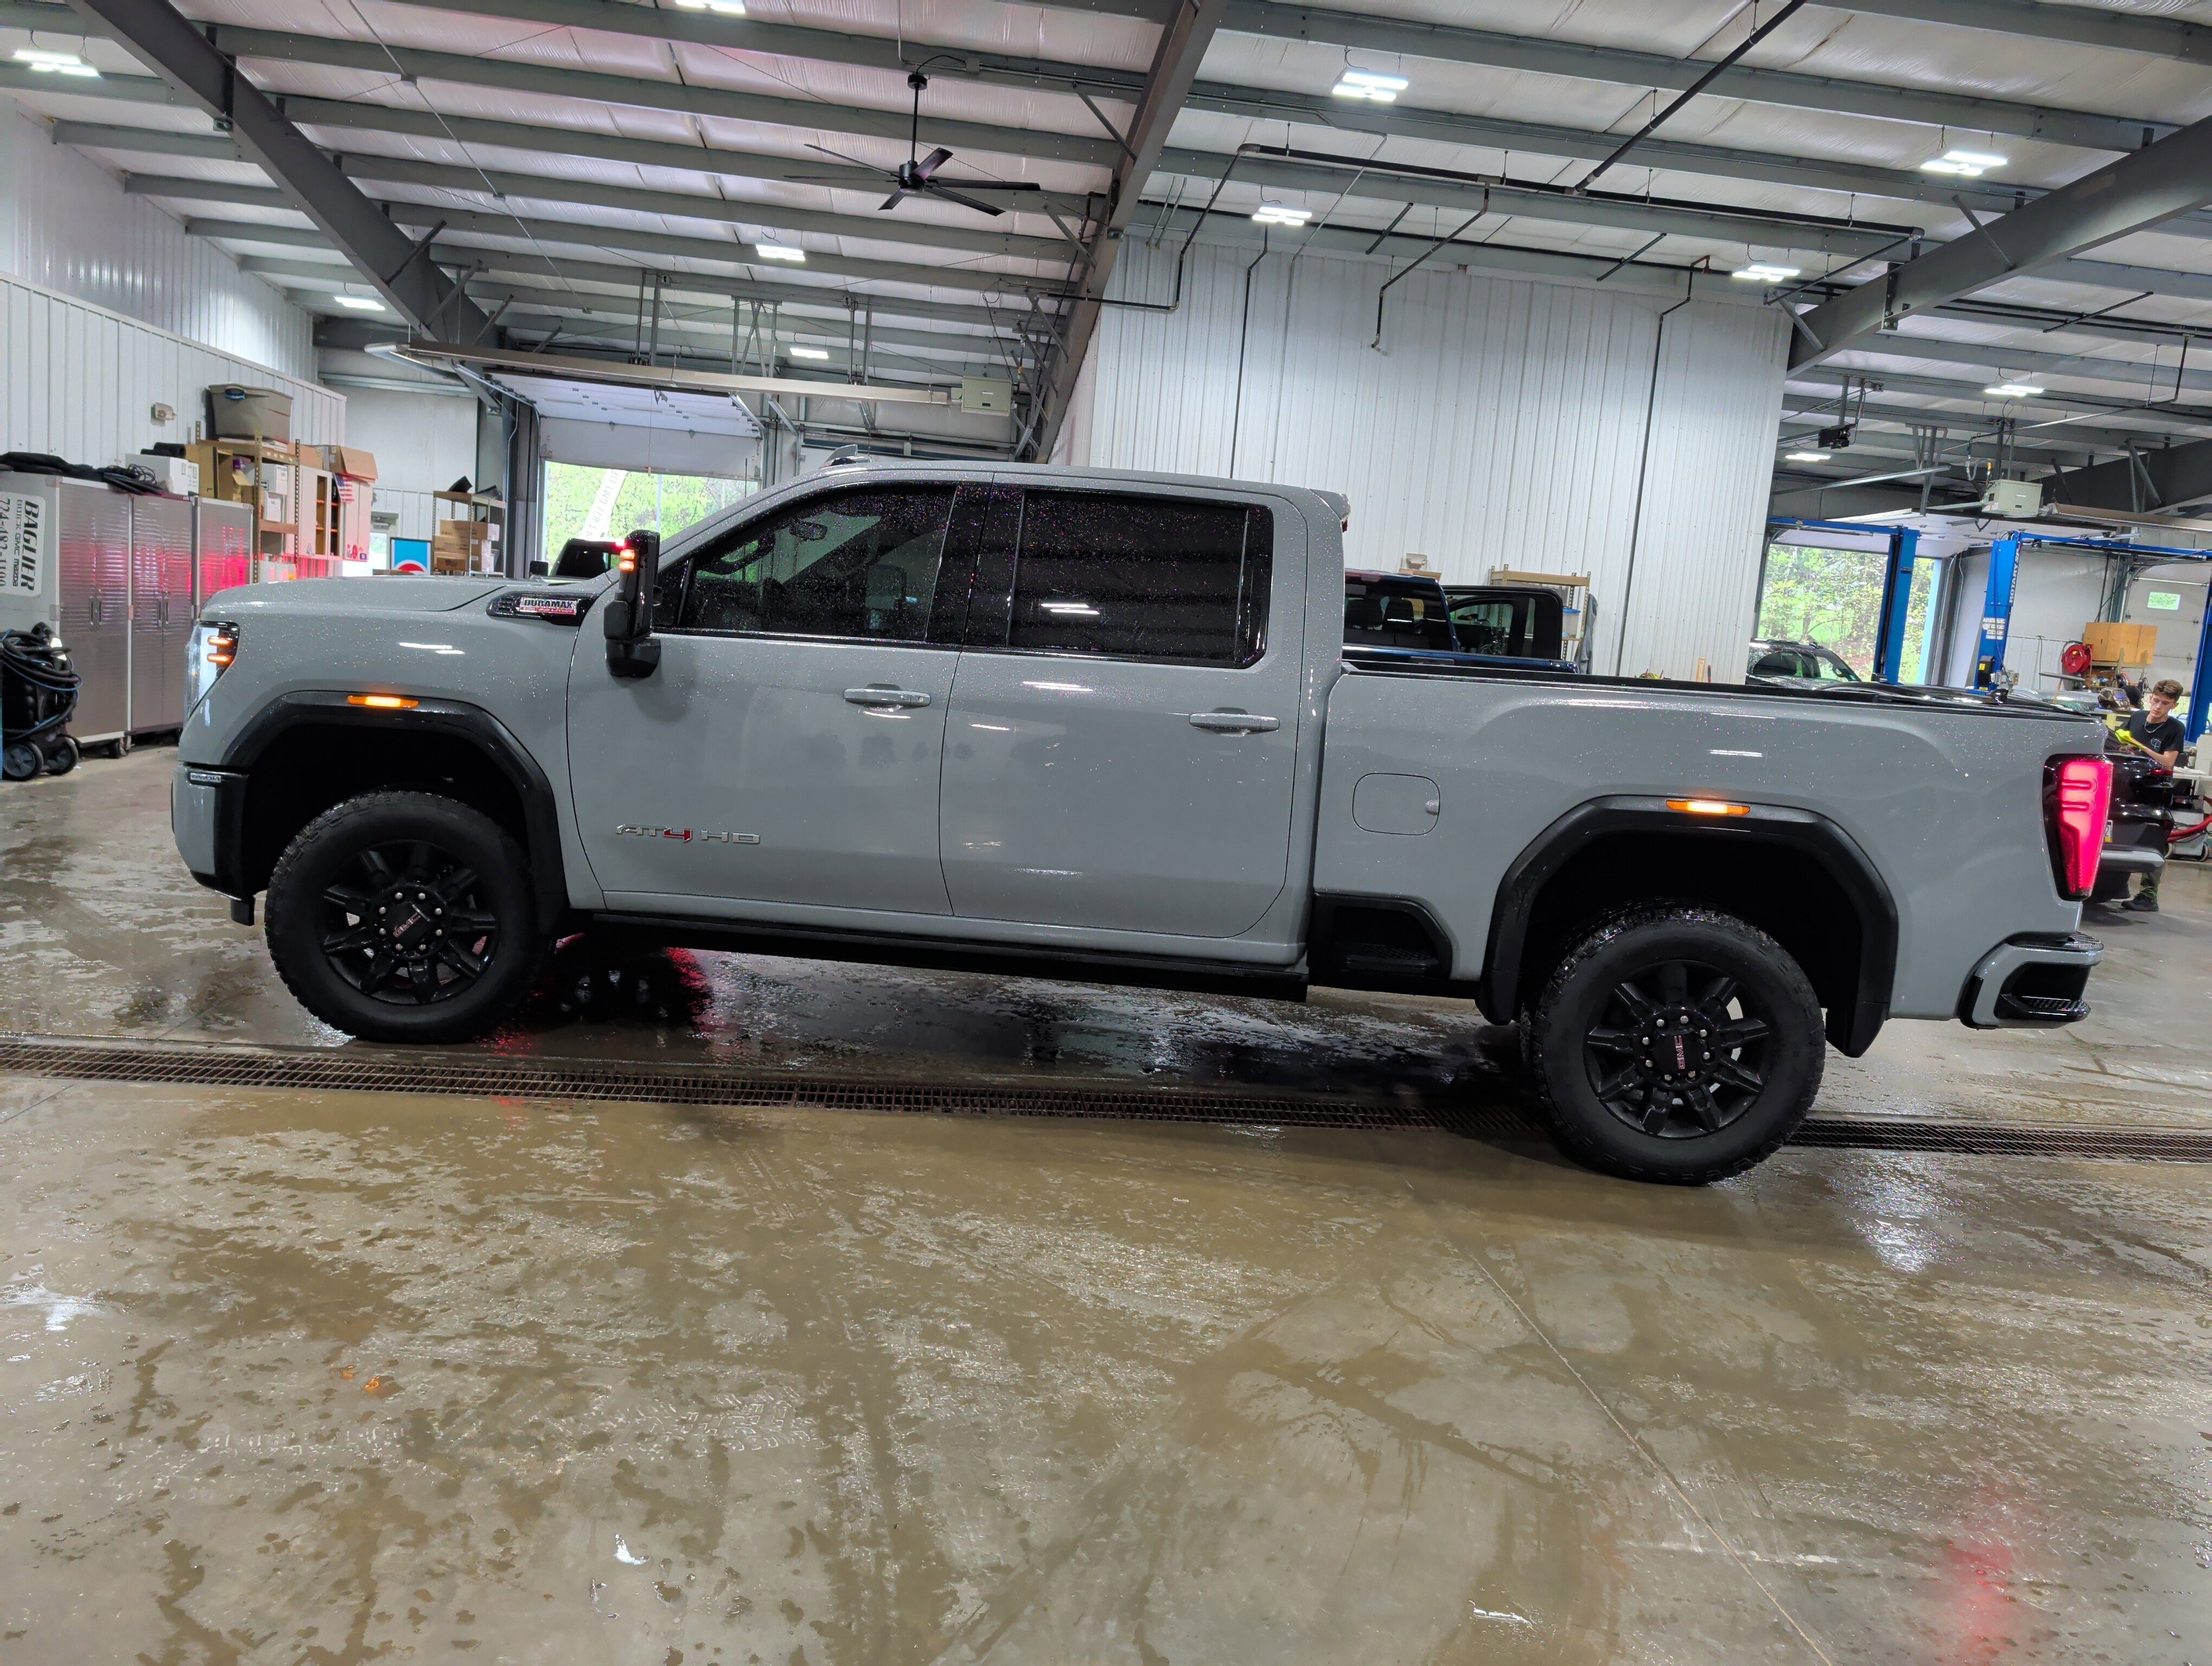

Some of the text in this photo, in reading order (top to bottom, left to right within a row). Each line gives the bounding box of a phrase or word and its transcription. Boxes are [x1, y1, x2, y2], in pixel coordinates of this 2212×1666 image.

[21, 500, 40, 591] BAGLIER
[523, 598, 574, 608] DURAMAX
[616, 824, 760, 844] AT4 HD
[393, 912, 421, 938] GMC
[1674, 1035, 1686, 1069] GMC
